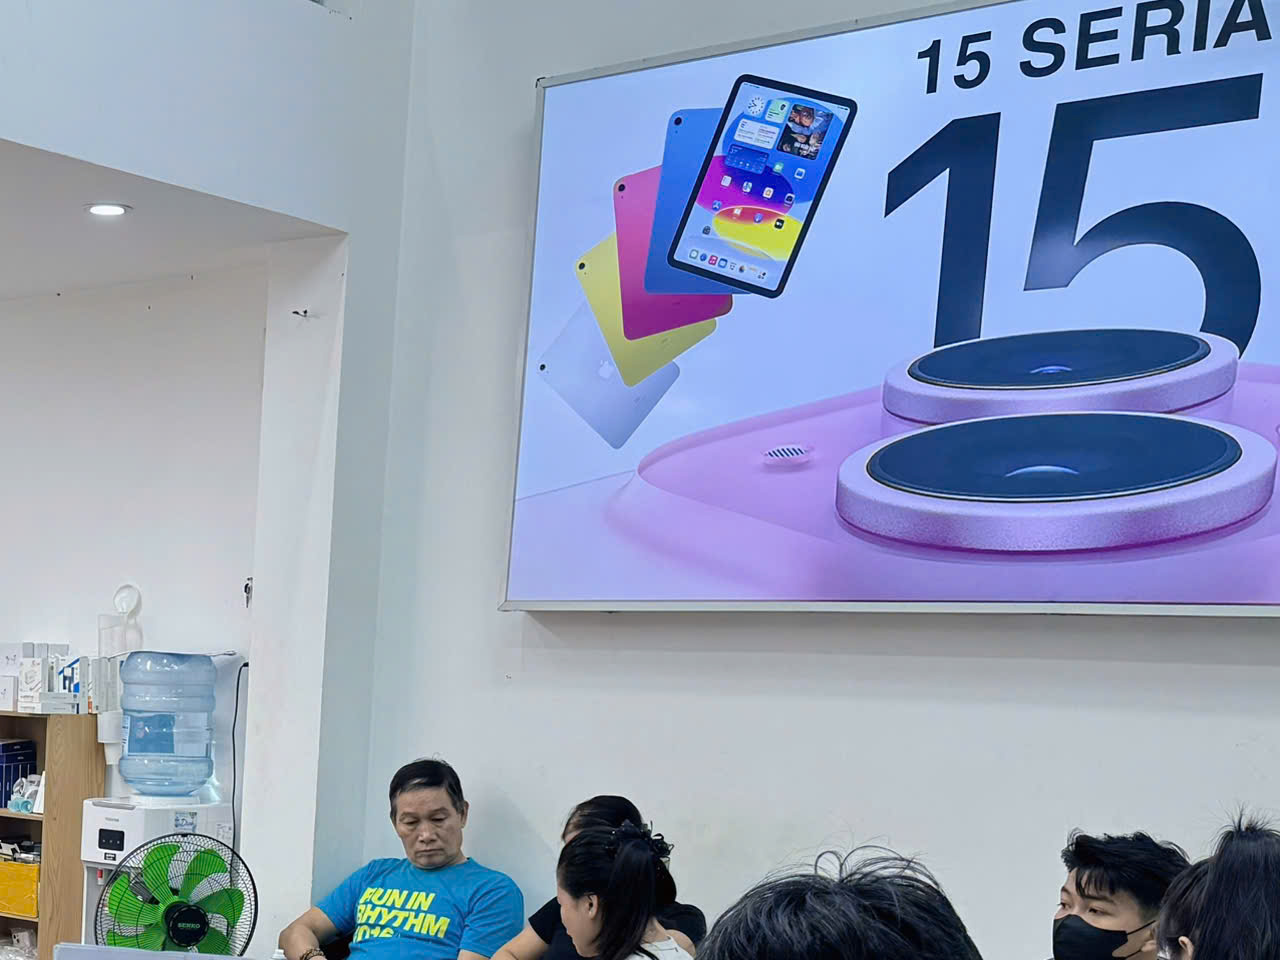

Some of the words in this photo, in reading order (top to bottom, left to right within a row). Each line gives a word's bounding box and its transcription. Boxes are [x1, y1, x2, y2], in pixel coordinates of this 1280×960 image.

[917, 30, 992, 95] 15
[884, 73, 1265, 358] 15
[406, 891, 436, 912] IN
